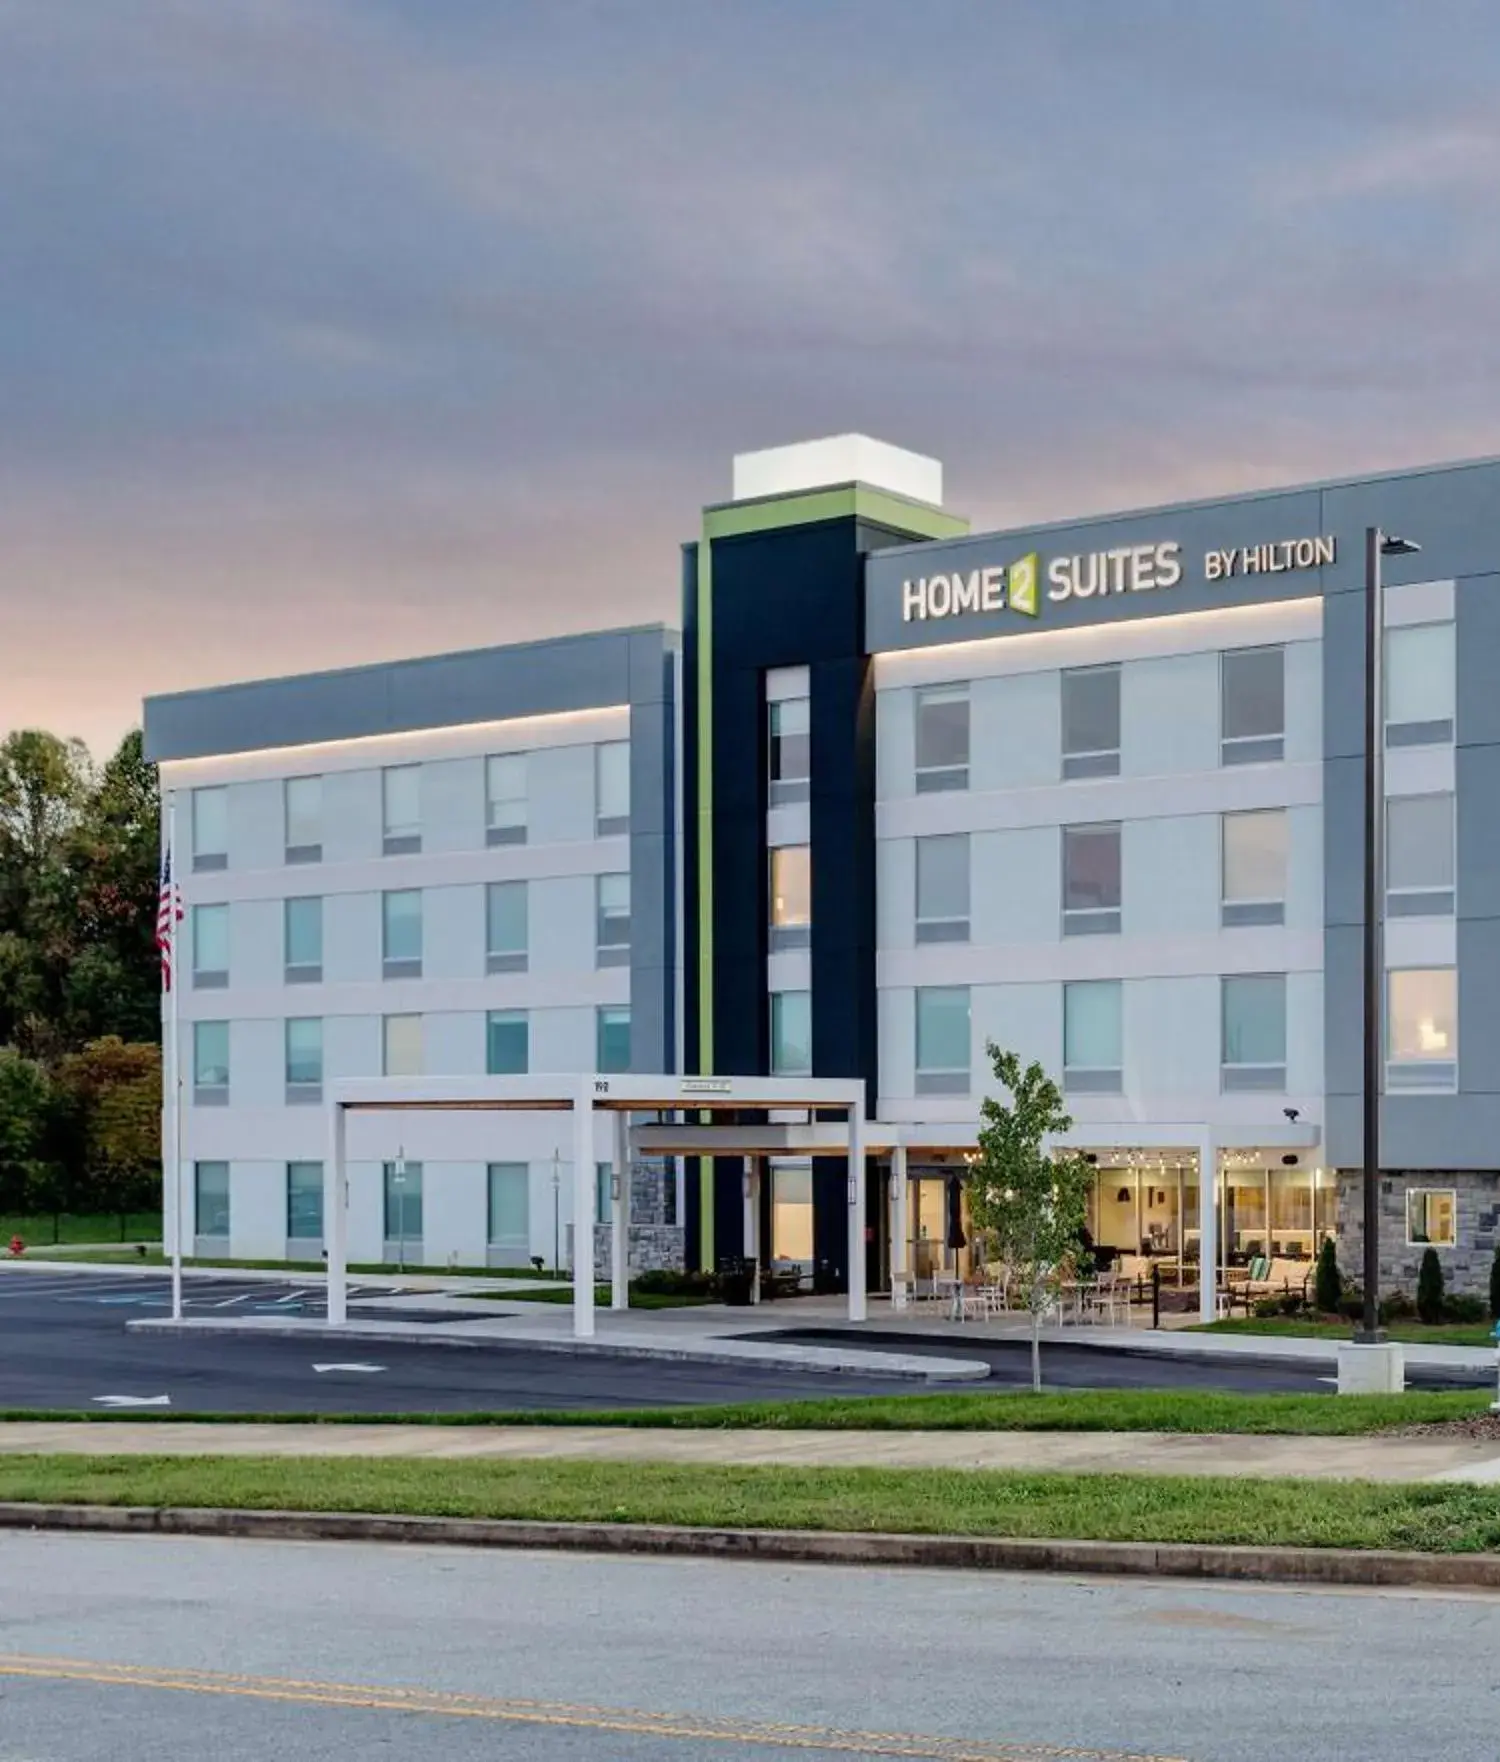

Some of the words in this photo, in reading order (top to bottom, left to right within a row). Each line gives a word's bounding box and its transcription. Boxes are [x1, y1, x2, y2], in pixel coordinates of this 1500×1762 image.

[1048, 541, 1182, 600] SUITES
[1204, 551, 1236, 580] BY
[1243, 536, 1335, 576] HILTON
